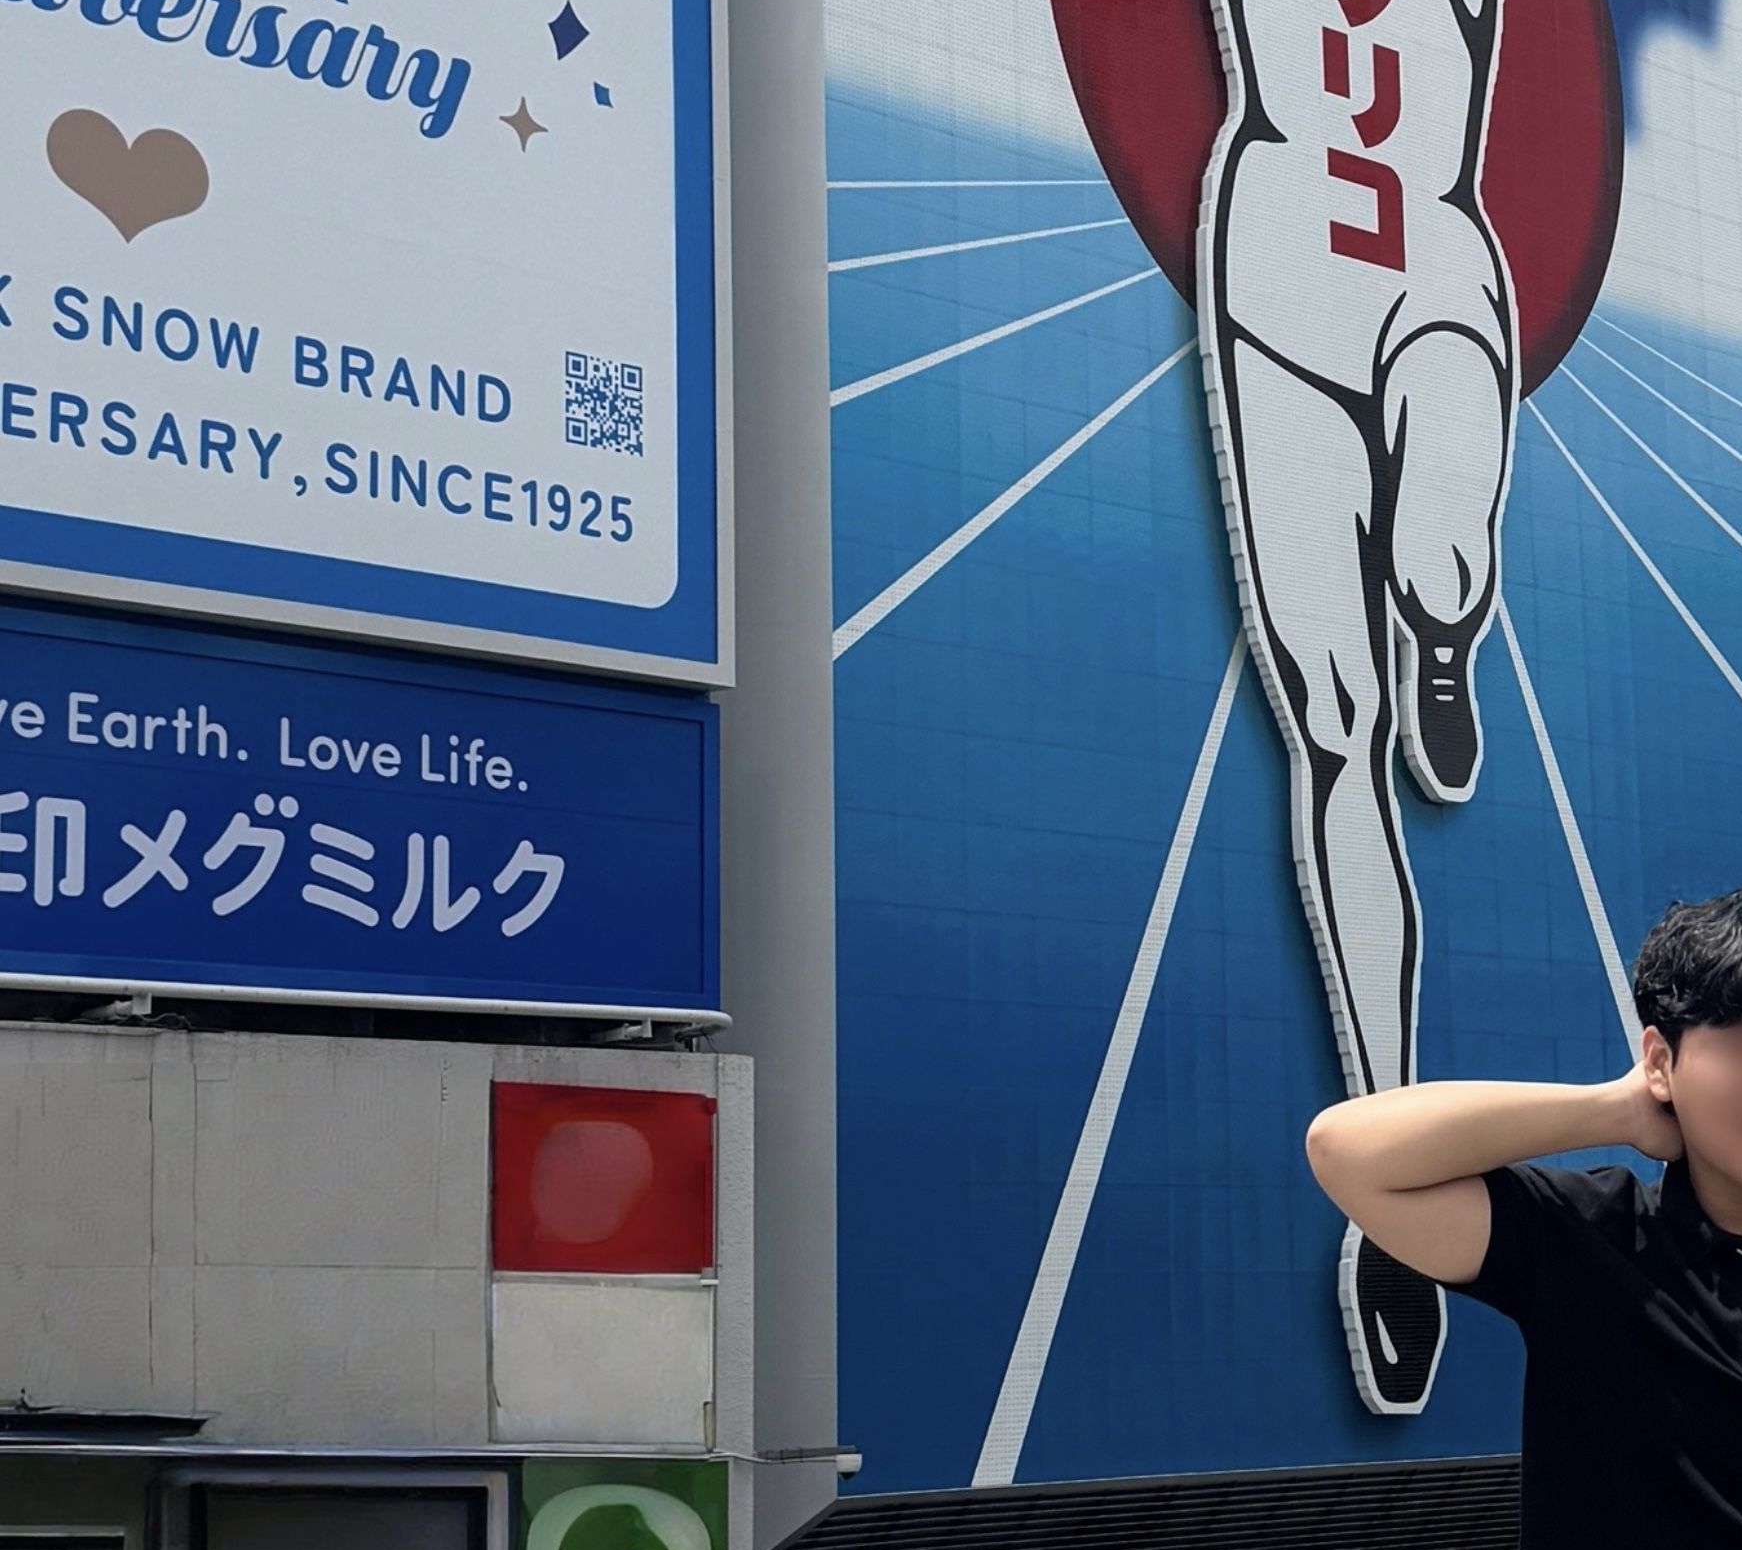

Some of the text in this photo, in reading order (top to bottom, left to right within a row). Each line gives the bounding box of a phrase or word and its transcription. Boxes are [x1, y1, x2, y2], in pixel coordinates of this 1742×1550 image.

[53, 286, 260, 374] SNOW
[294, 335, 512, 423] BRAND
[68, 692, 249, 761] Earth.
[280, 717, 401, 775] Love
[421, 734, 528, 792] Life.
